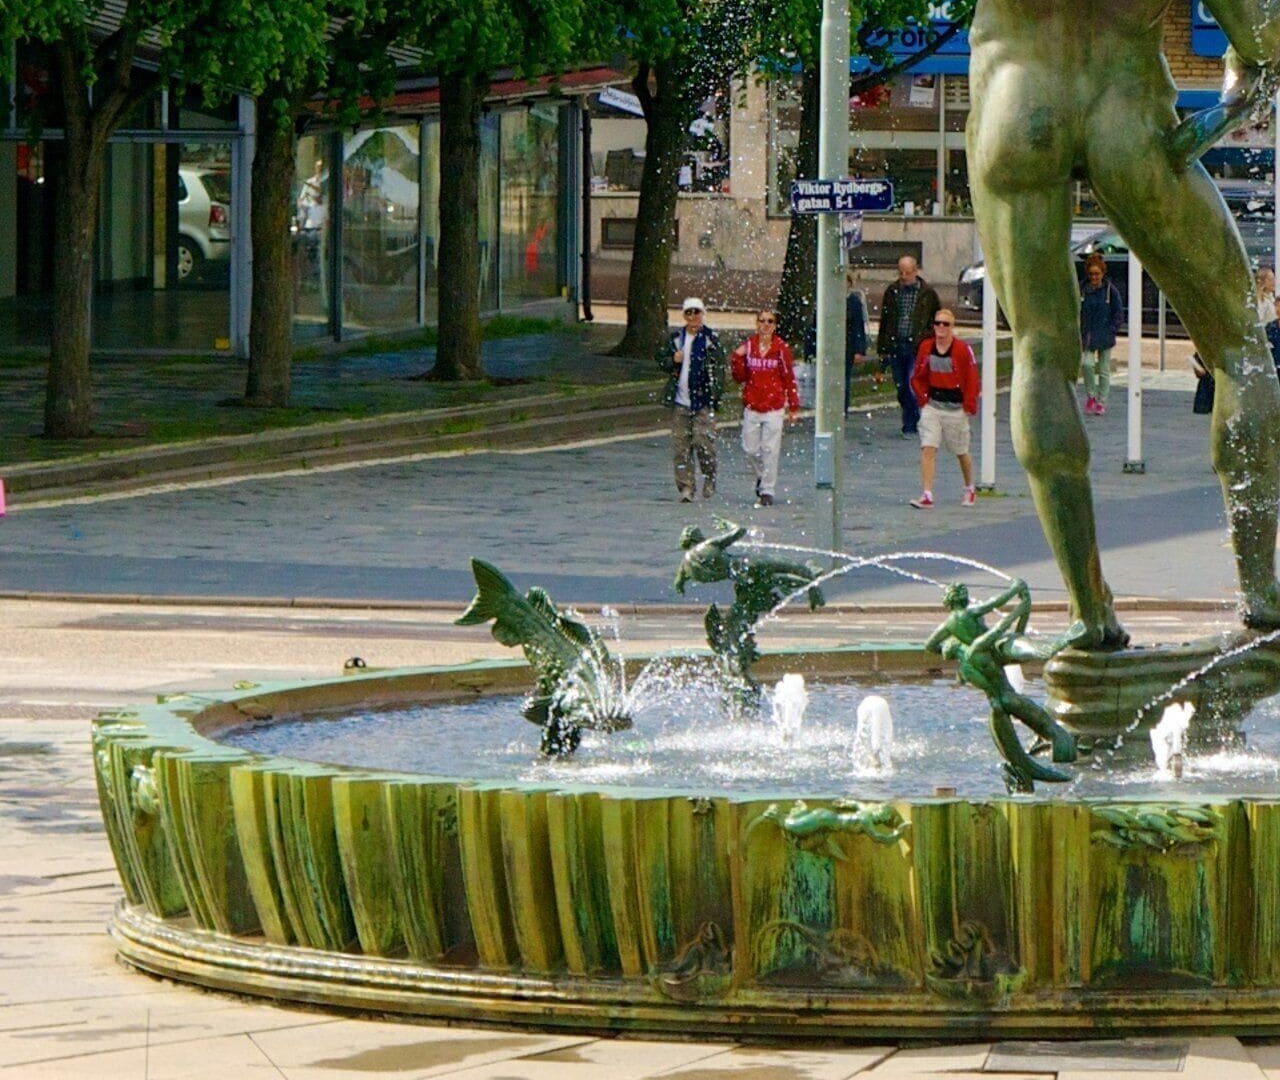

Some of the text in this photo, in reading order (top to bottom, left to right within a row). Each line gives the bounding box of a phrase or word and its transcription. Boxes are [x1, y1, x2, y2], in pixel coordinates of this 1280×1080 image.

[798, 182, 887, 196] Viktor Rydbergs-
[798, 198, 831, 211] gatan
